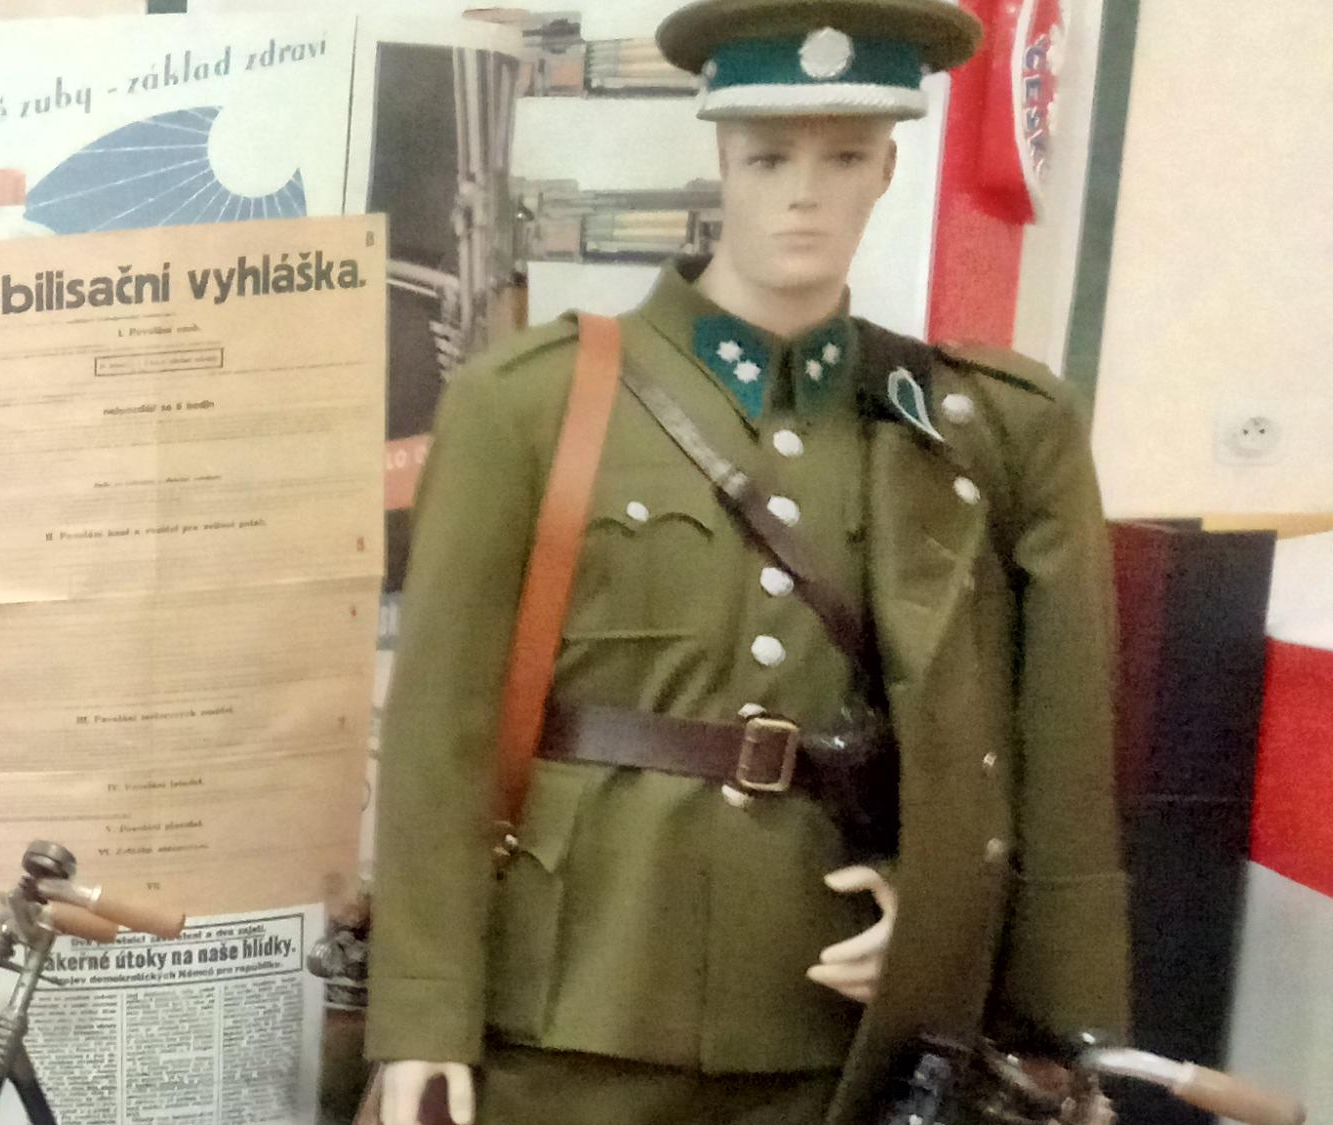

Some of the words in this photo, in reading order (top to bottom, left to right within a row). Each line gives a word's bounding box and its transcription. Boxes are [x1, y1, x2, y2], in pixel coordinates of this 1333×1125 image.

[19, 76, 93, 119] zuby
[126, 45, 232, 95] základ
[244, 32, 328, 71] zdraví
[187, 250, 367, 305] vyhláška.
[41, 949, 111, 972] ákeřné
[115, 948, 167, 972] útoky
[171, 950, 193, 967] na
[198, 943, 239, 964] naše
[242, 936, 297, 960] hlídky.
